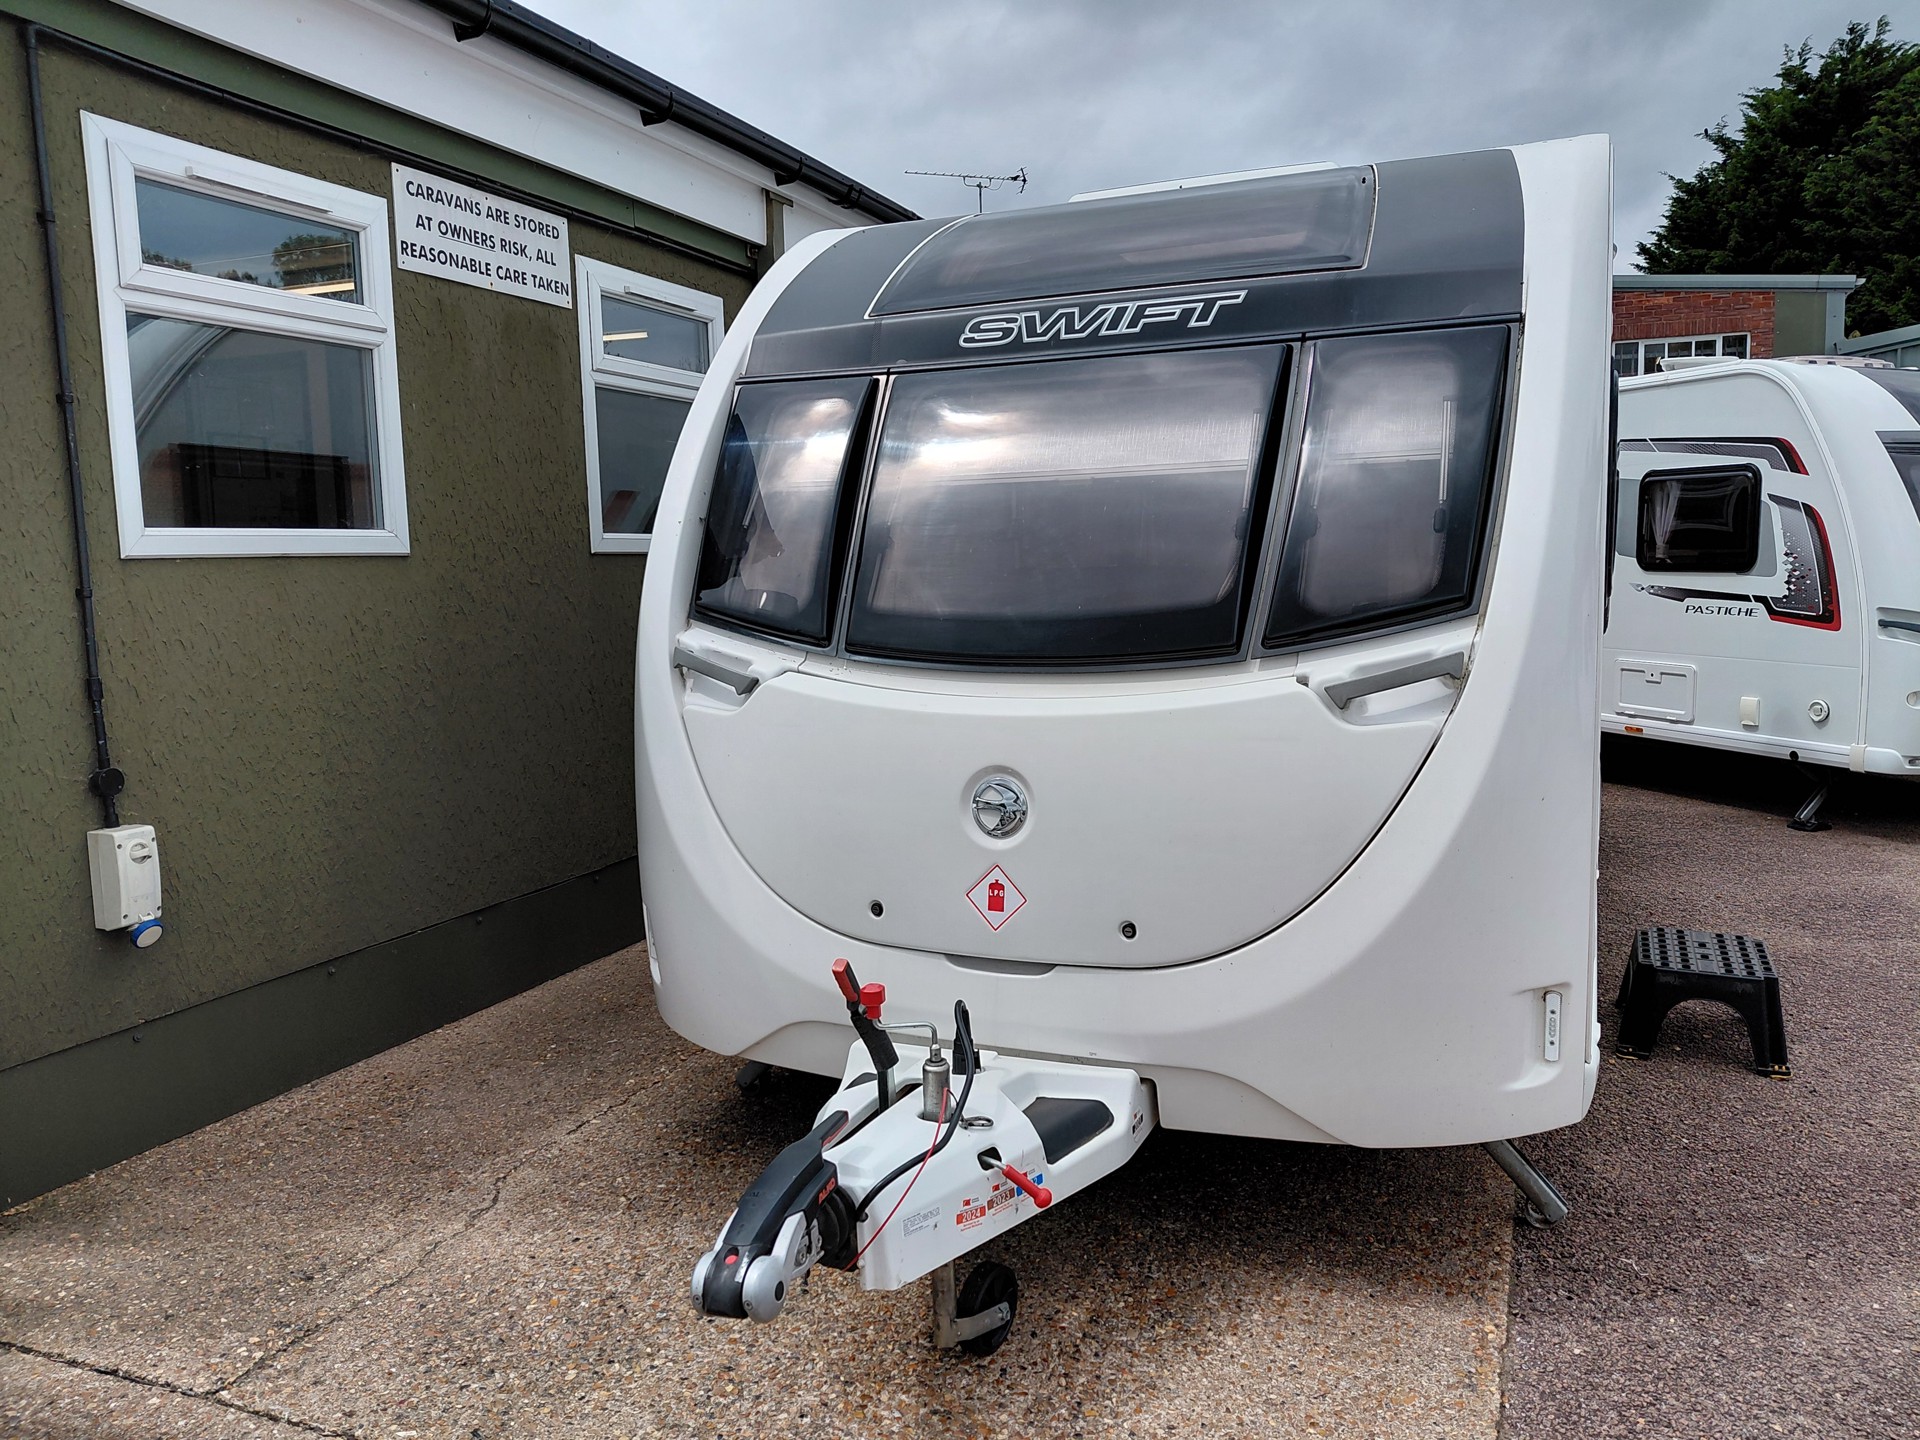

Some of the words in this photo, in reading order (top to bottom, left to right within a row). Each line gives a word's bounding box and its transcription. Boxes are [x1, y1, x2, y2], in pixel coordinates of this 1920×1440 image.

[405, 180, 482, 217] CARAVANS
[485, 206, 510, 226] ARE
[513, 214, 560, 240] STORED
[415, 214, 433, 232] AT
[437, 220, 496, 250] OWNERS
[500, 238, 532, 262] RISK,
[535, 248, 557, 266] ALL
[400, 240, 492, 277] REASONABLE
[495, 265, 528, 286] CARE
[530, 274, 570, 297] TAKEN
[958, 289, 1249, 348] SWIFT
[1684, 604, 1760, 618] PASTICHE
[989, 888, 1004, 898] LPG
[962, 1208, 981, 1223] 2024
[992, 1190, 1011, 1208] 2023
